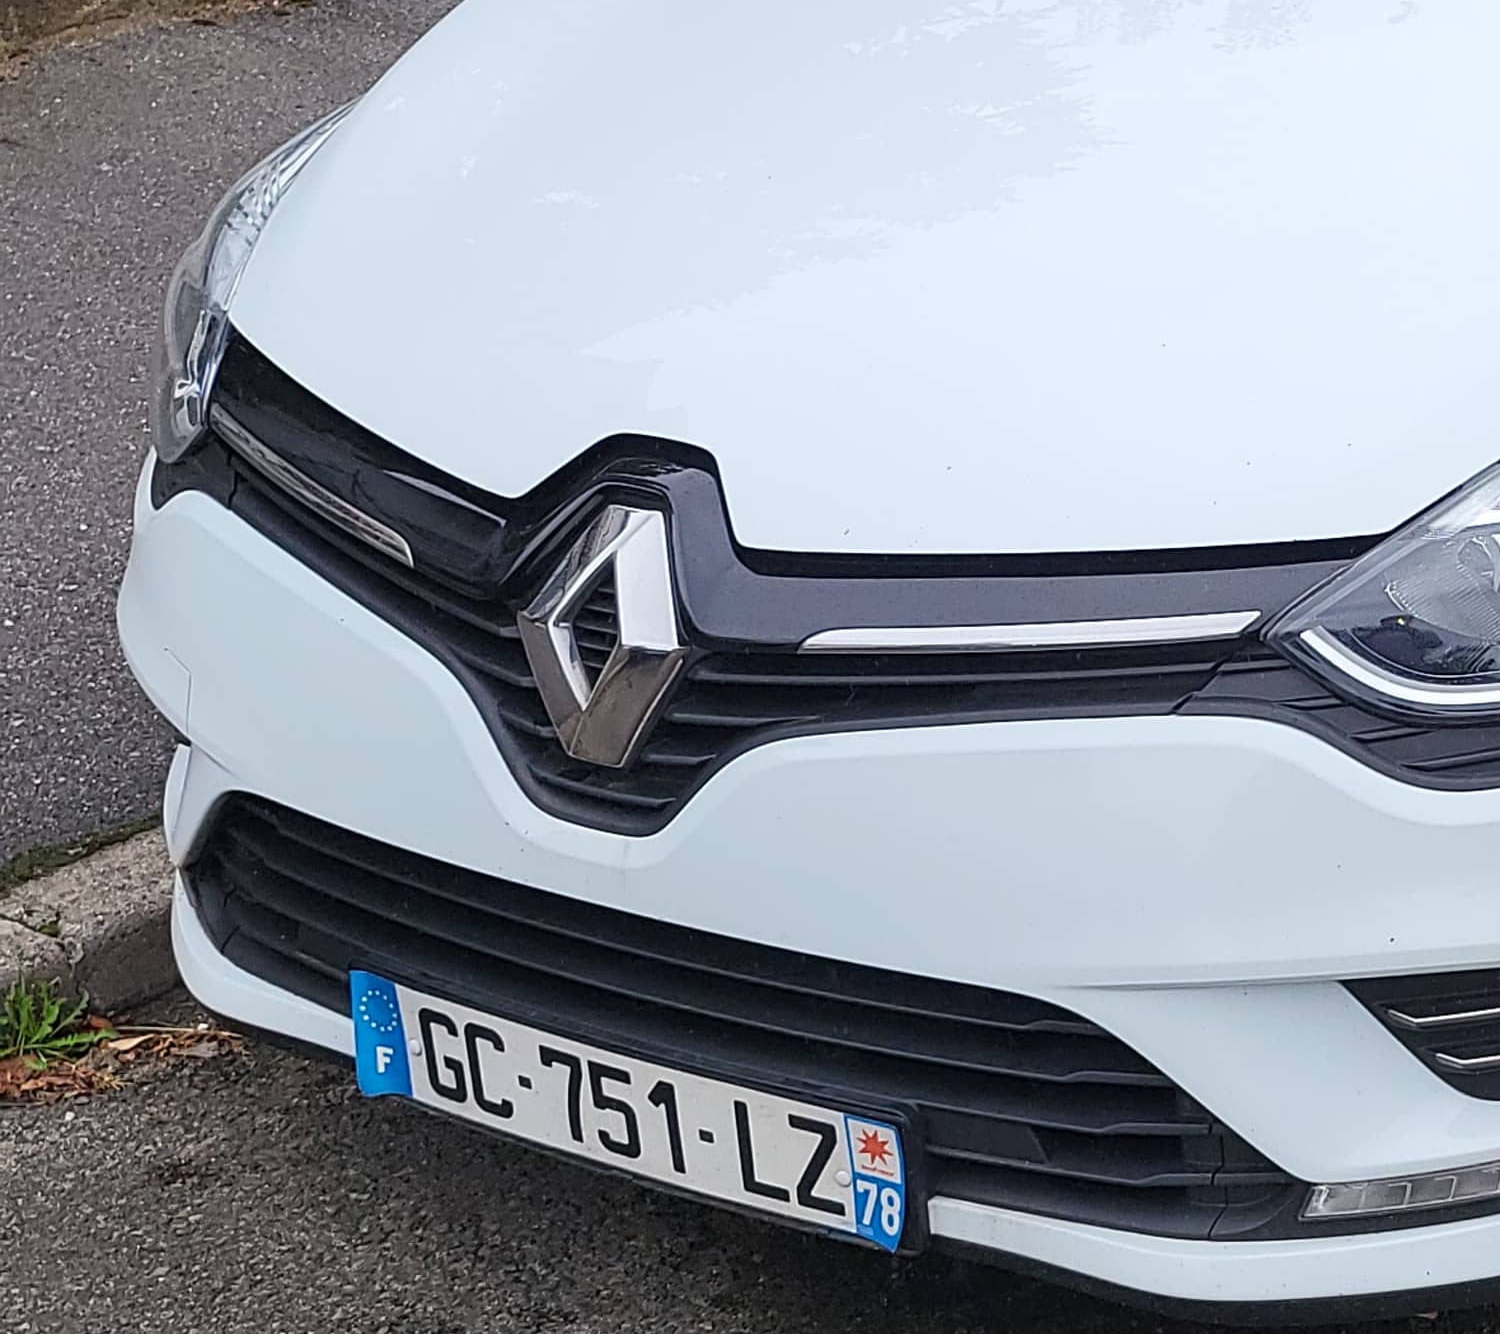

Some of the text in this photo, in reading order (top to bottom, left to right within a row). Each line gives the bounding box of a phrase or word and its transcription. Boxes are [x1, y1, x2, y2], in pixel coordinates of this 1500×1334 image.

[376, 1045, 394, 1074] F
[417, 1008, 847, 1217] GC-751-LZ
[857, 1179, 901, 1236] 78
